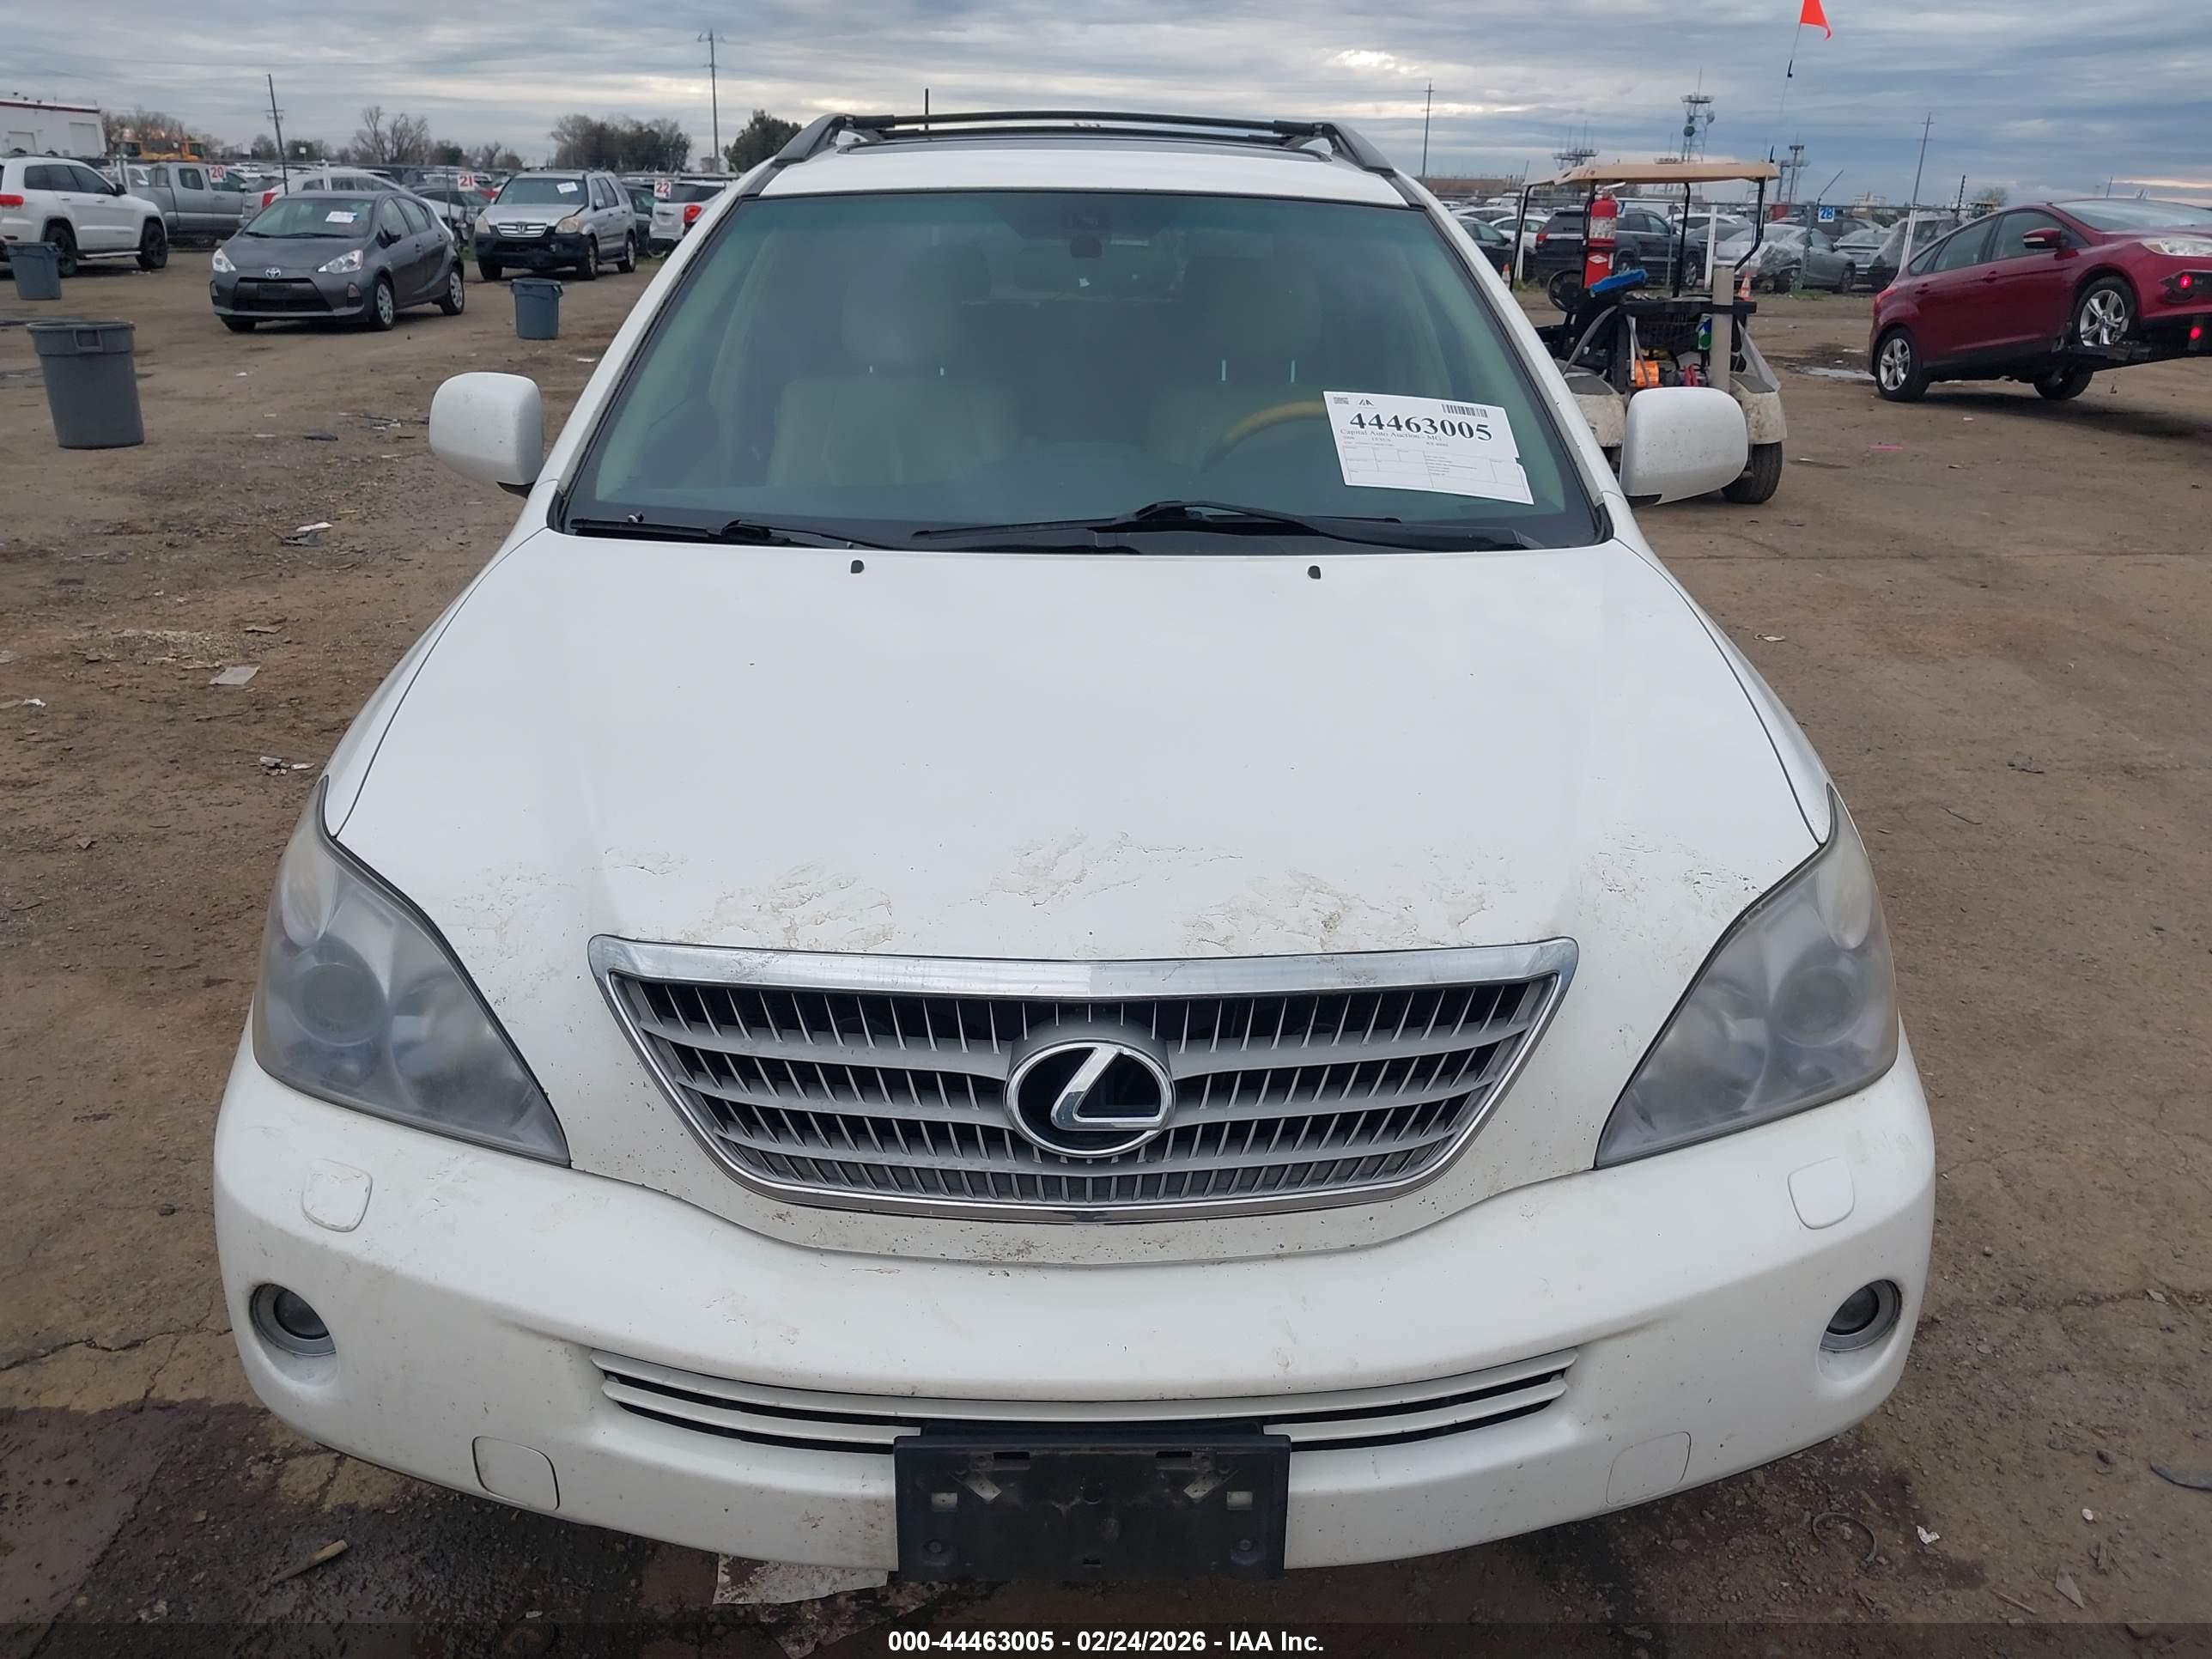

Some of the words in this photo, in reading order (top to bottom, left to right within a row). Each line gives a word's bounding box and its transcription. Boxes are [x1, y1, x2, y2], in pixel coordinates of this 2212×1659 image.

[210, 167, 224, 179] 20
[459, 175, 474, 187] 21
[656, 182, 670, 193] 22
[1820, 207, 1834, 220] 28
[1349, 412, 1492, 441] 44463005
